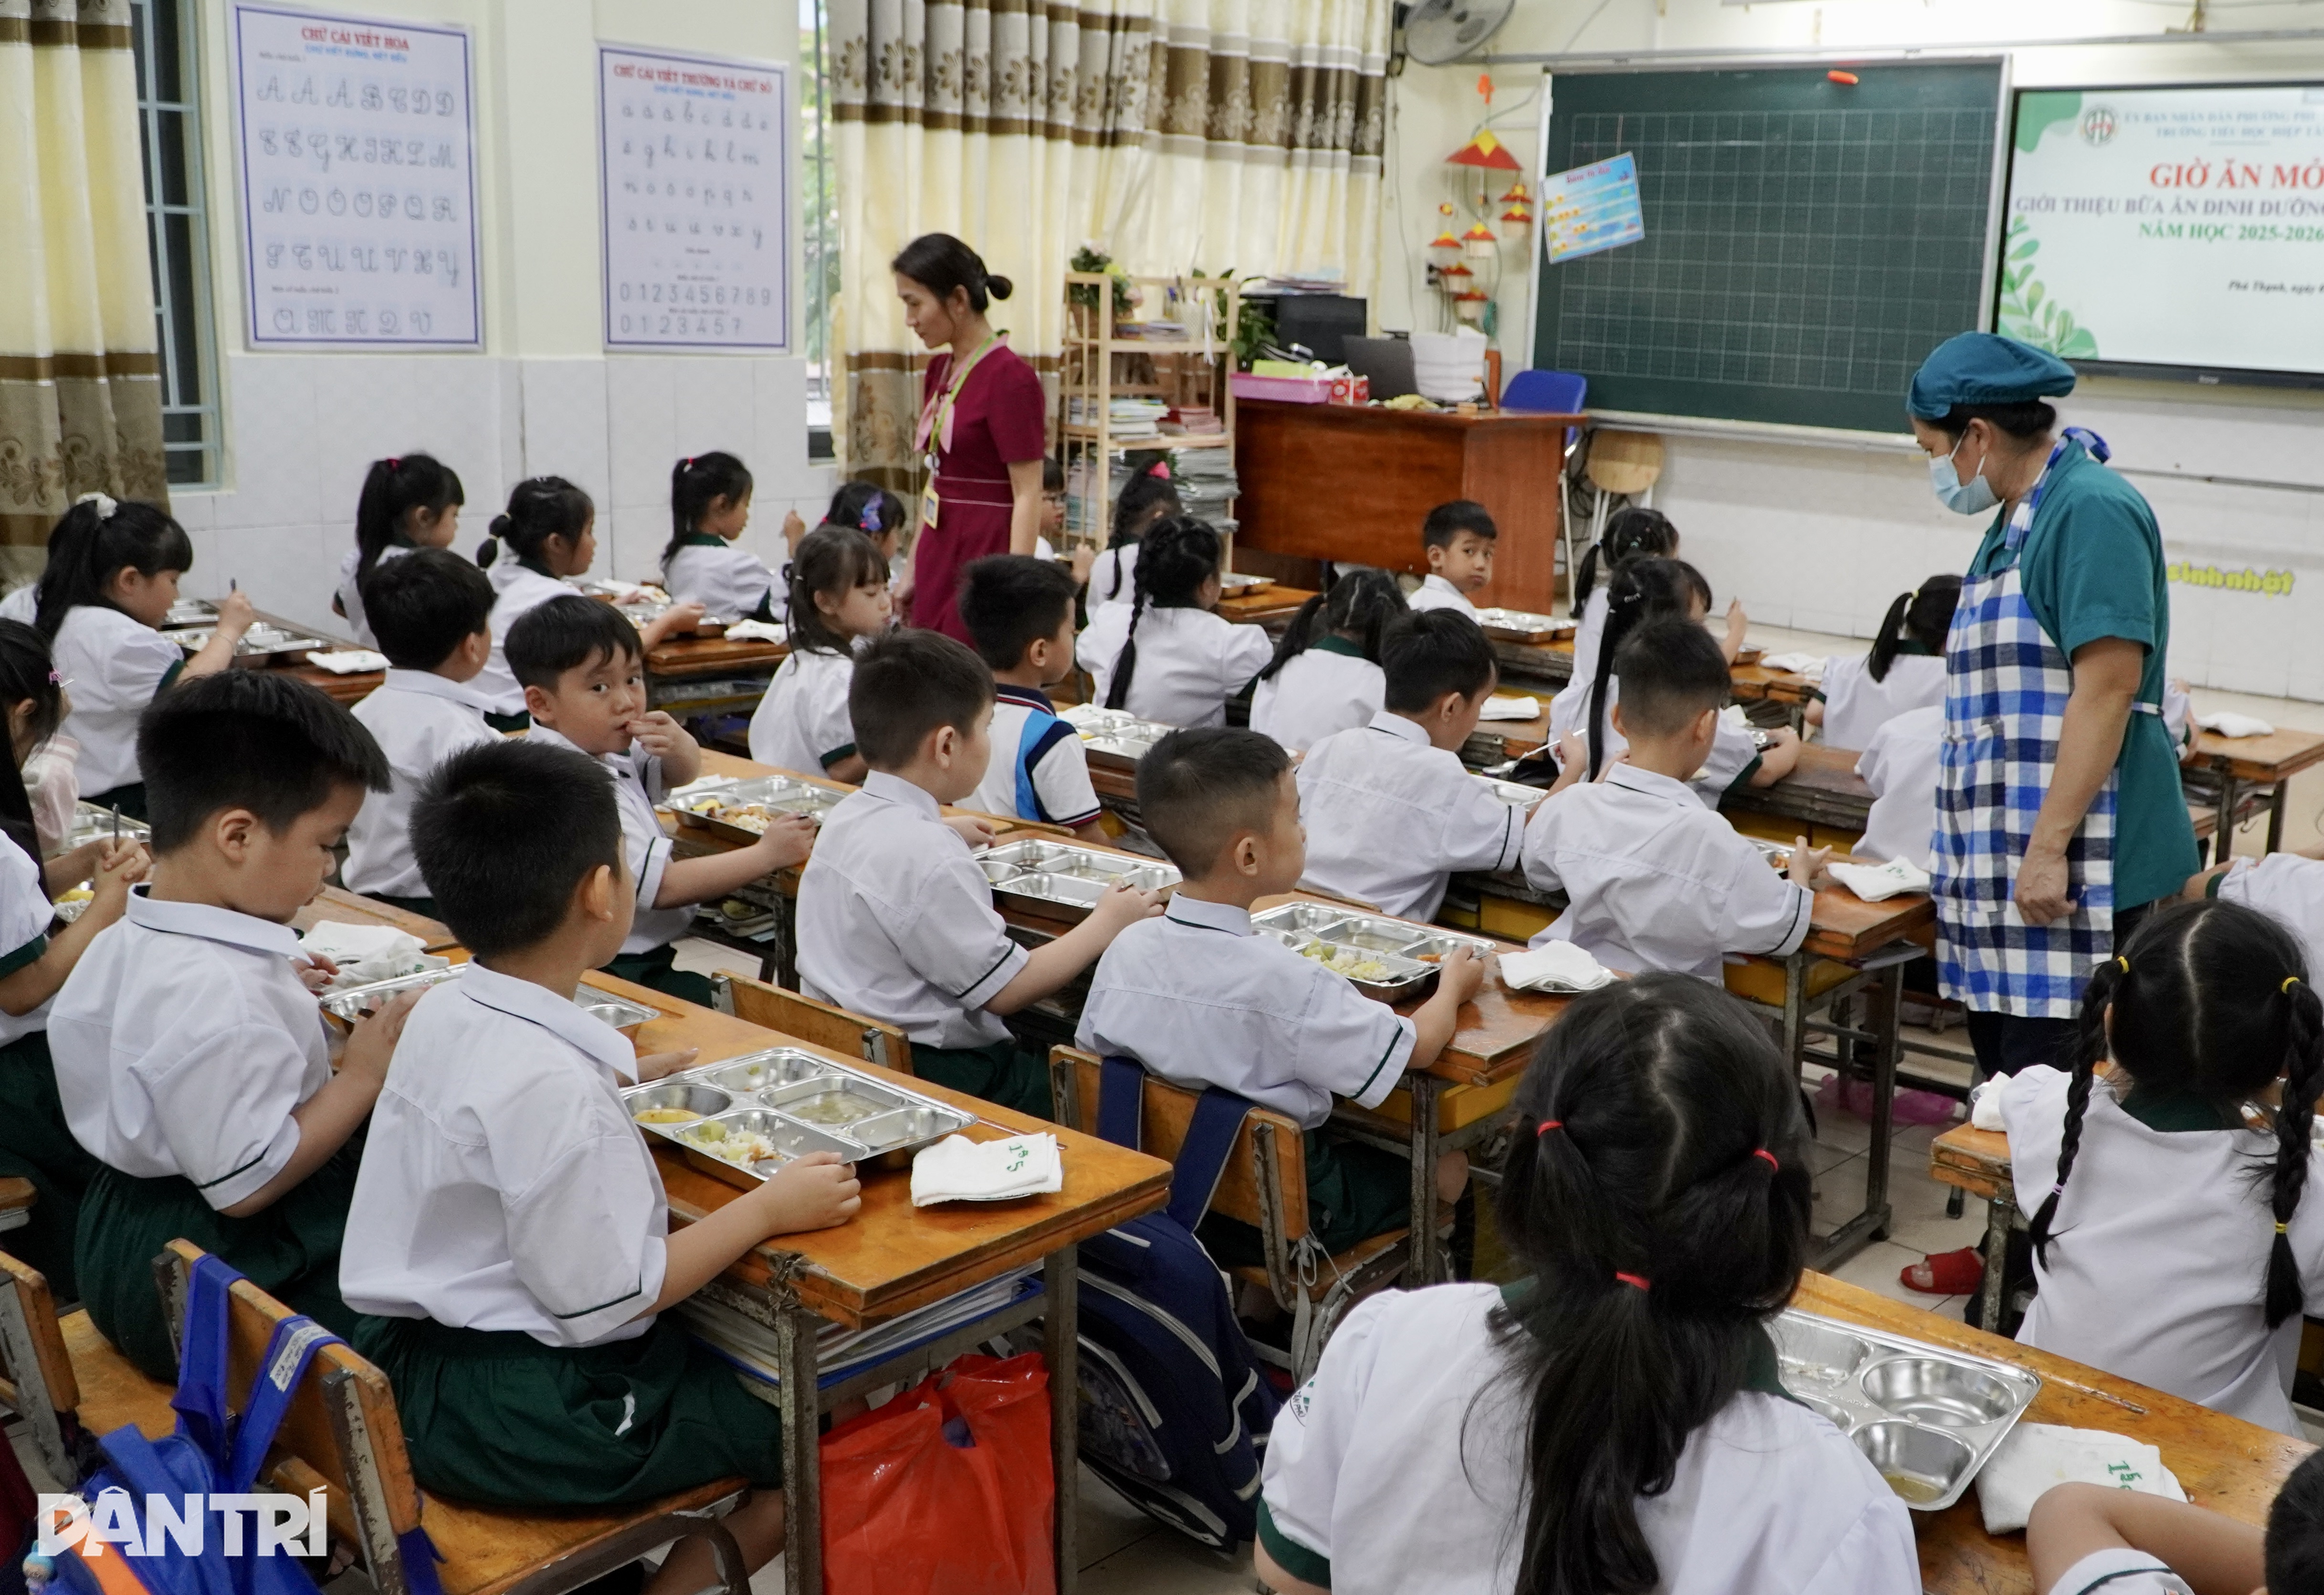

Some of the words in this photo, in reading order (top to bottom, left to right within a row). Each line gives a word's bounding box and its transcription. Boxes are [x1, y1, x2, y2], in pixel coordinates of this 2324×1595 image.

[2150, 157, 2211, 188] GIỜ
[2217, 158, 2261, 188] ĂN
[2015, 192, 2056, 213] GIỚI
[2062, 196, 2120, 217] THIỆU
[2125, 193, 2164, 213] BỮA
[2171, 195, 2198, 214] ĂN
[2203, 198, 2253, 215] DINH
[2138, 219, 2183, 238] NĂM
[2189, 222, 2233, 243] HỌC
[620, 282, 631, 302] 0
[641, 283, 647, 301] 1
[652, 283, 662, 303] 2
[669, 283, 678, 303] 3
[700, 285, 710, 304] 5
[730, 285, 740, 304] 7
[620, 314, 631, 334] 0
[659, 315, 671, 334] 2
[677, 316, 687, 335] 3
[714, 317, 724, 335] 5
